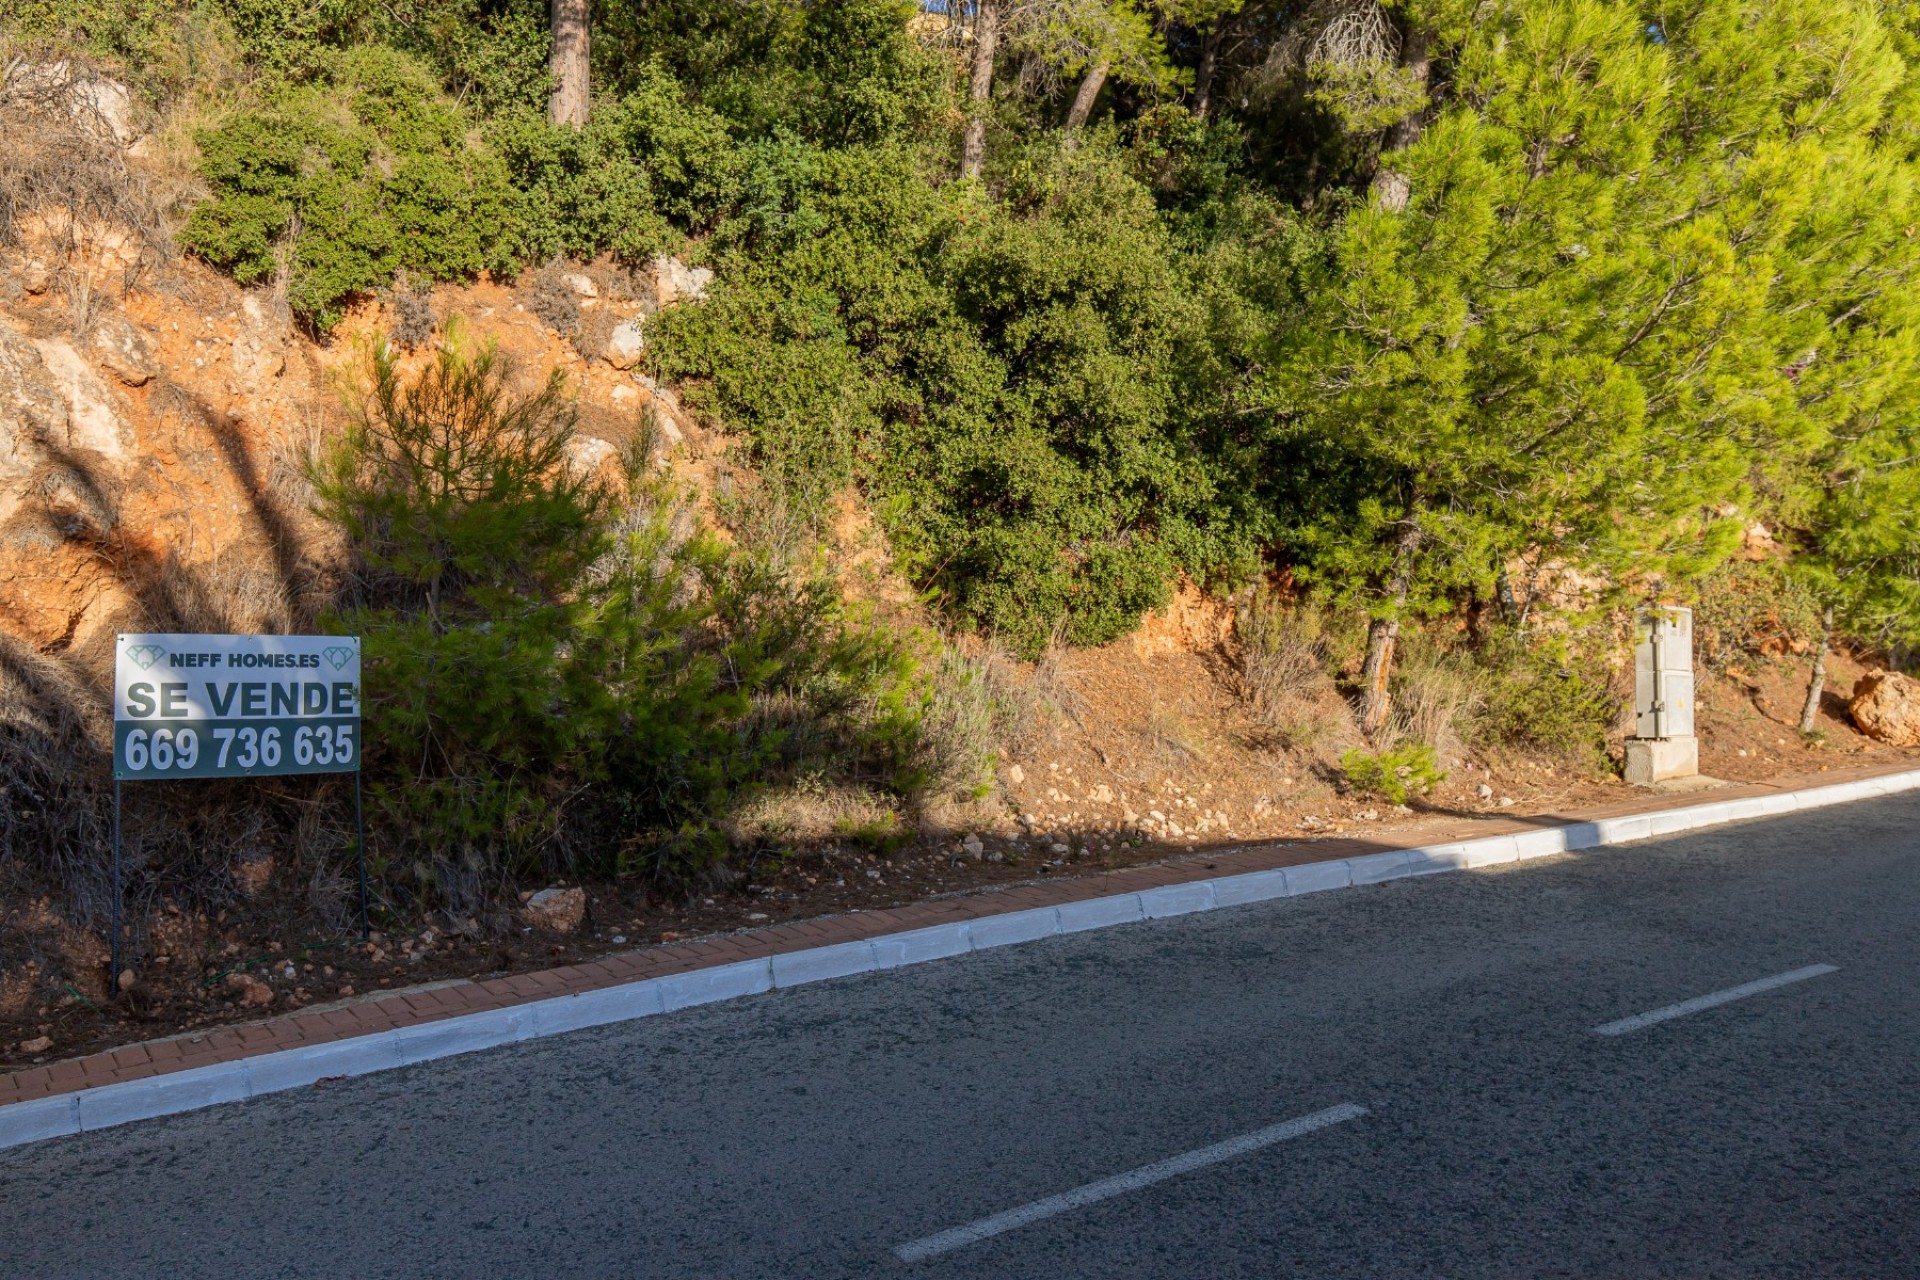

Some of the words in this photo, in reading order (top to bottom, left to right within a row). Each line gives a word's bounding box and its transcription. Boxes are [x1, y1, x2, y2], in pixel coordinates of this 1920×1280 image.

[170, 653, 221, 668] NEFF
[228, 653, 320, 668] HOMES.ES
[126, 682, 189, 718] SE
[205, 682, 354, 717] VENDE
[125, 728, 199, 771] 669
[212, 726, 282, 768] 736
[293, 725, 354, 766] 635
